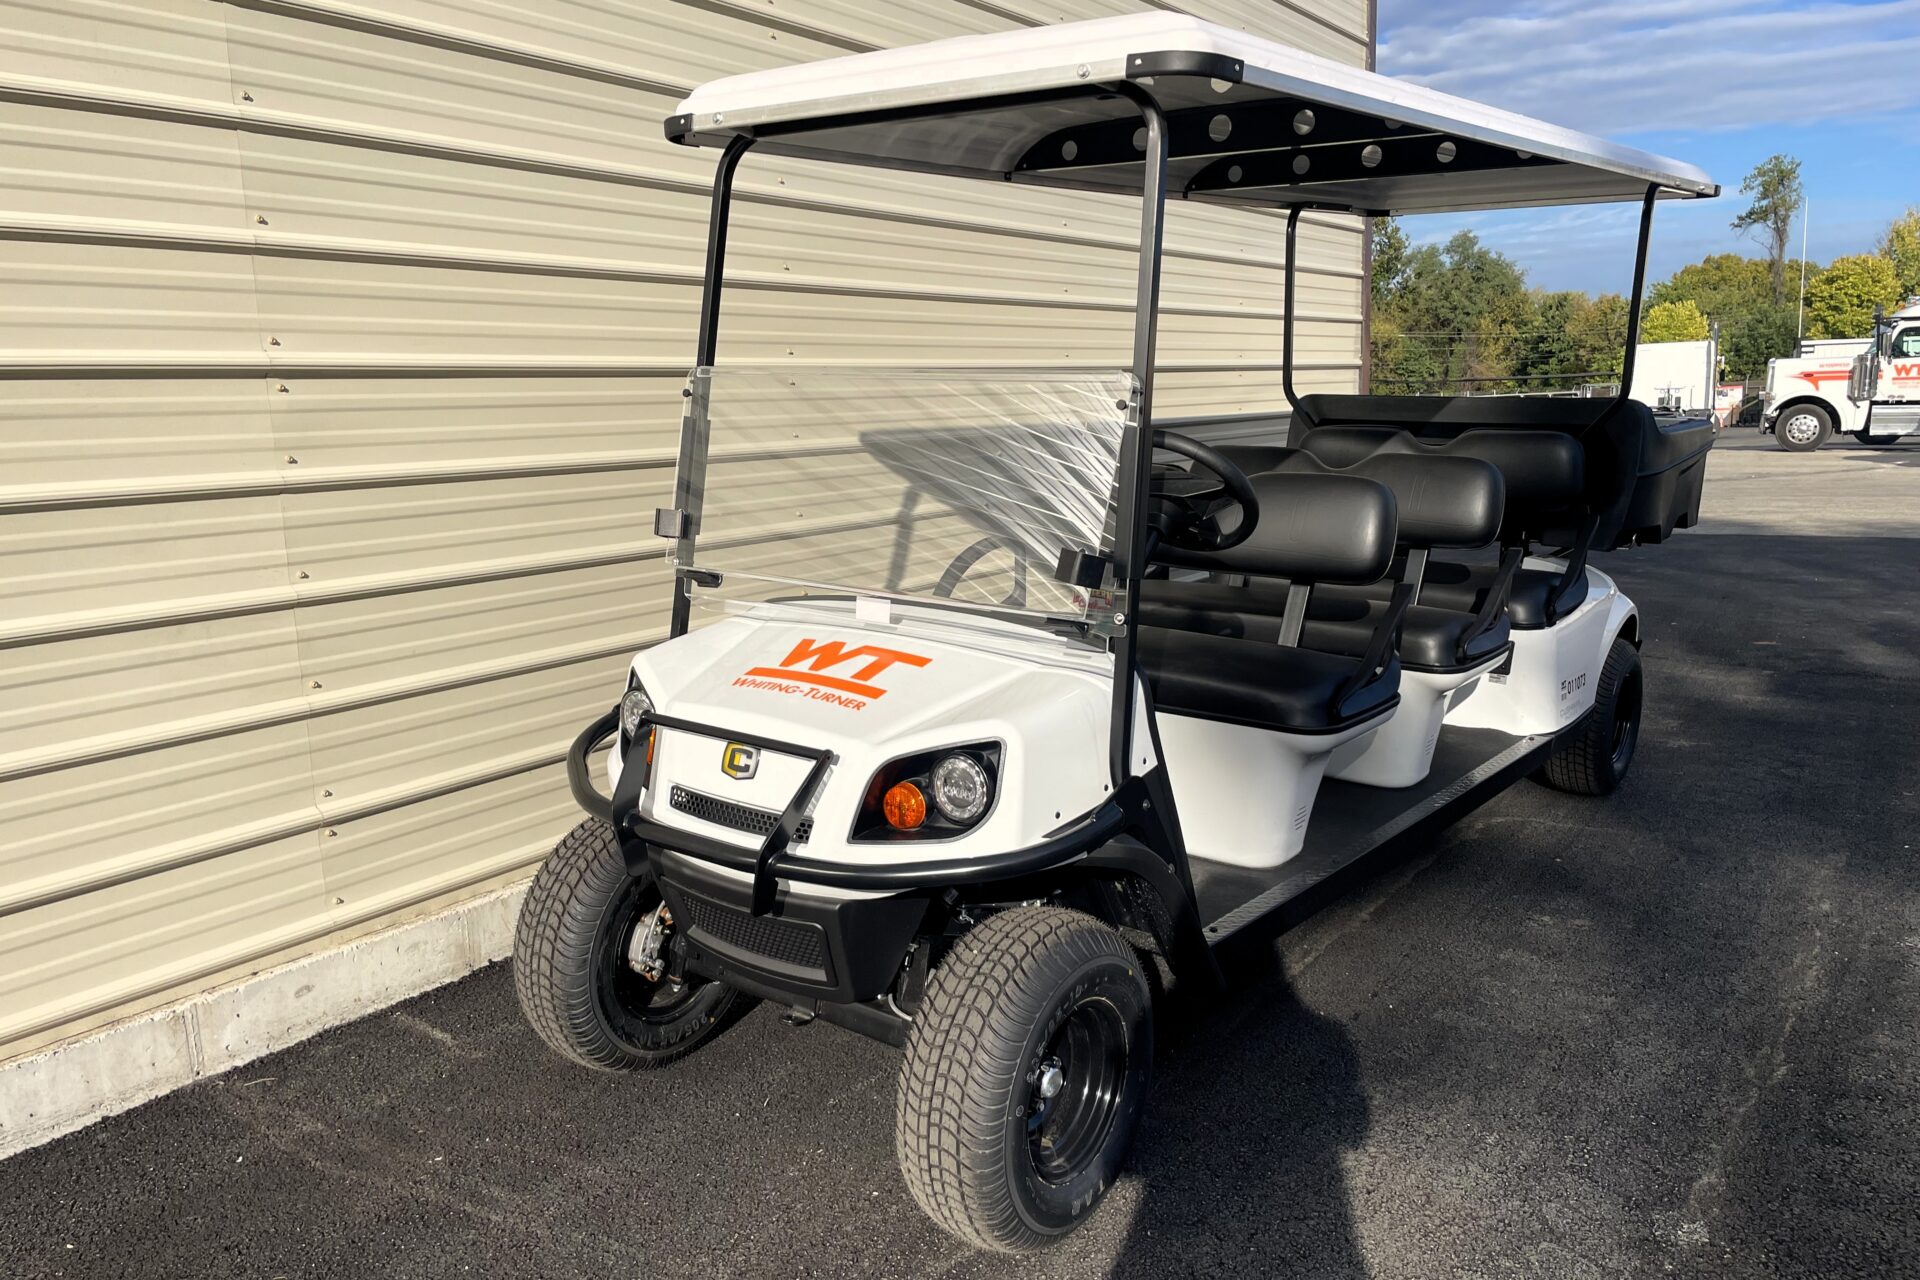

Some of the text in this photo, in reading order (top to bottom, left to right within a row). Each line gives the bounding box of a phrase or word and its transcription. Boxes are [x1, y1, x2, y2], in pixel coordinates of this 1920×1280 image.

[779, 638, 933, 682] WT
[732, 677, 867, 711] WHITING-TURNER
[1567, 673, 1586, 695] 011073
